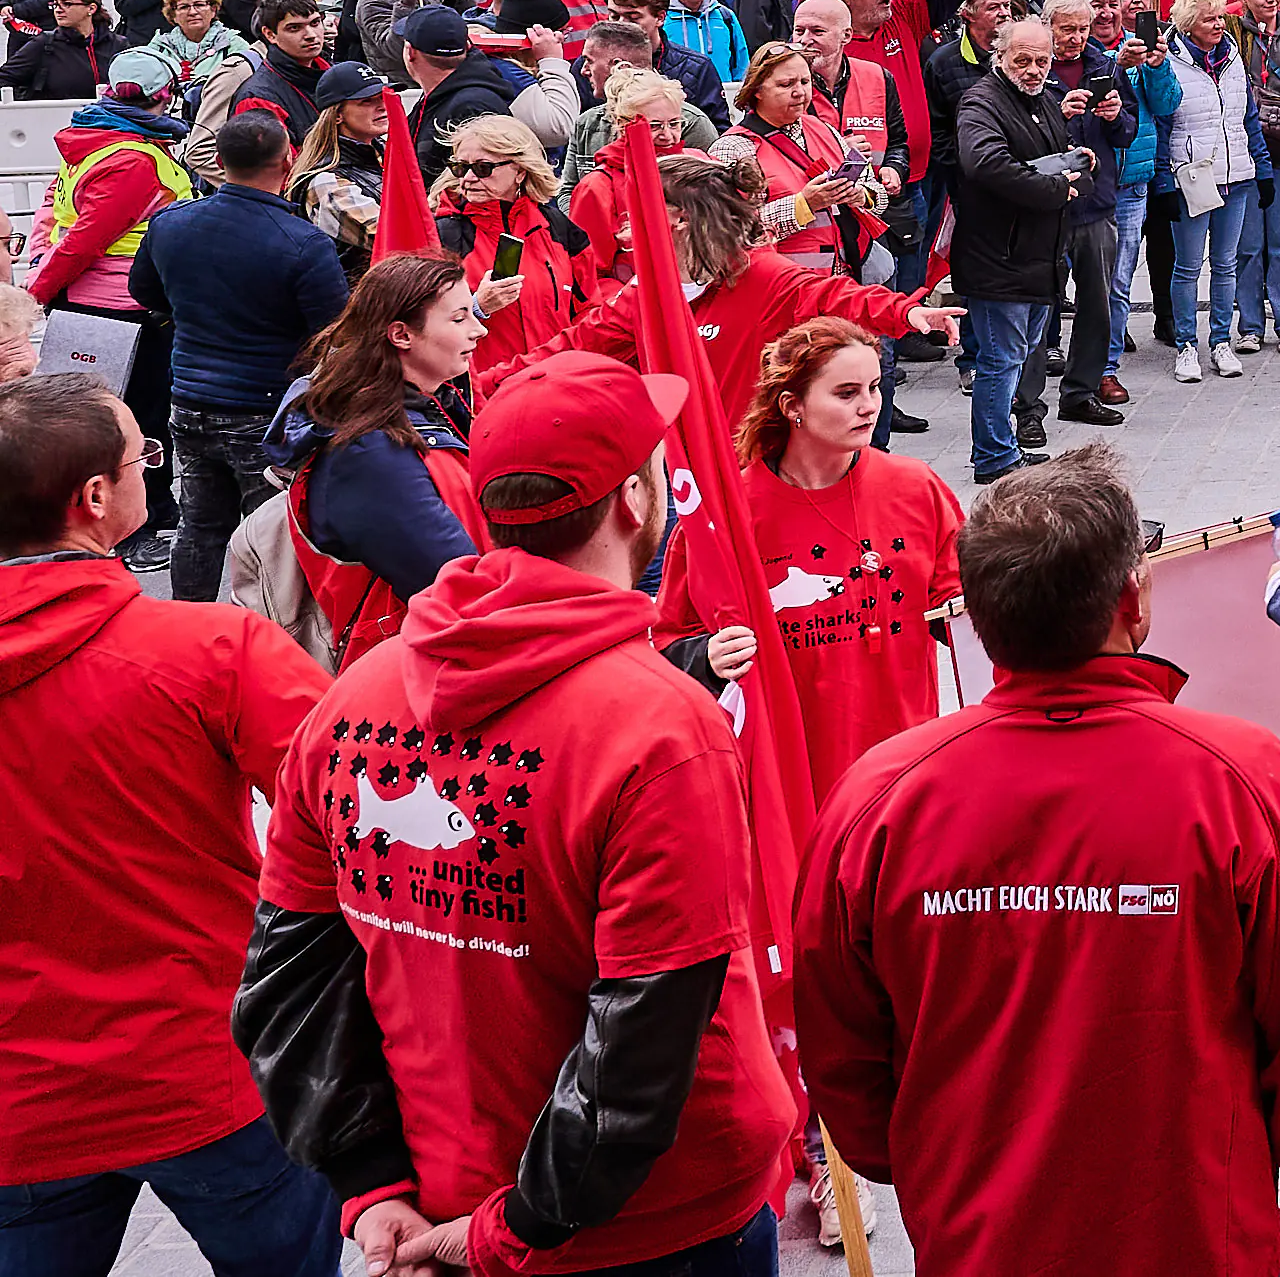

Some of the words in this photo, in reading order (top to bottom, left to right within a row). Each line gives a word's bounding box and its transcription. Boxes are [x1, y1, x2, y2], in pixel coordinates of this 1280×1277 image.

[433, 860, 525, 894] united
[410, 878, 455, 917] tiny
[461, 888, 527, 923] fish!
[923, 887, 994, 916] MACHT
[999, 885, 1049, 912] EUCH
[1054, 885, 1113, 912] STARK
[1153, 889, 1175, 907] NÖ
[392, 920, 414, 935] will
[416, 926, 447, 943] never
[449, 934, 465, 949] be
[469, 936, 530, 958] divided!
